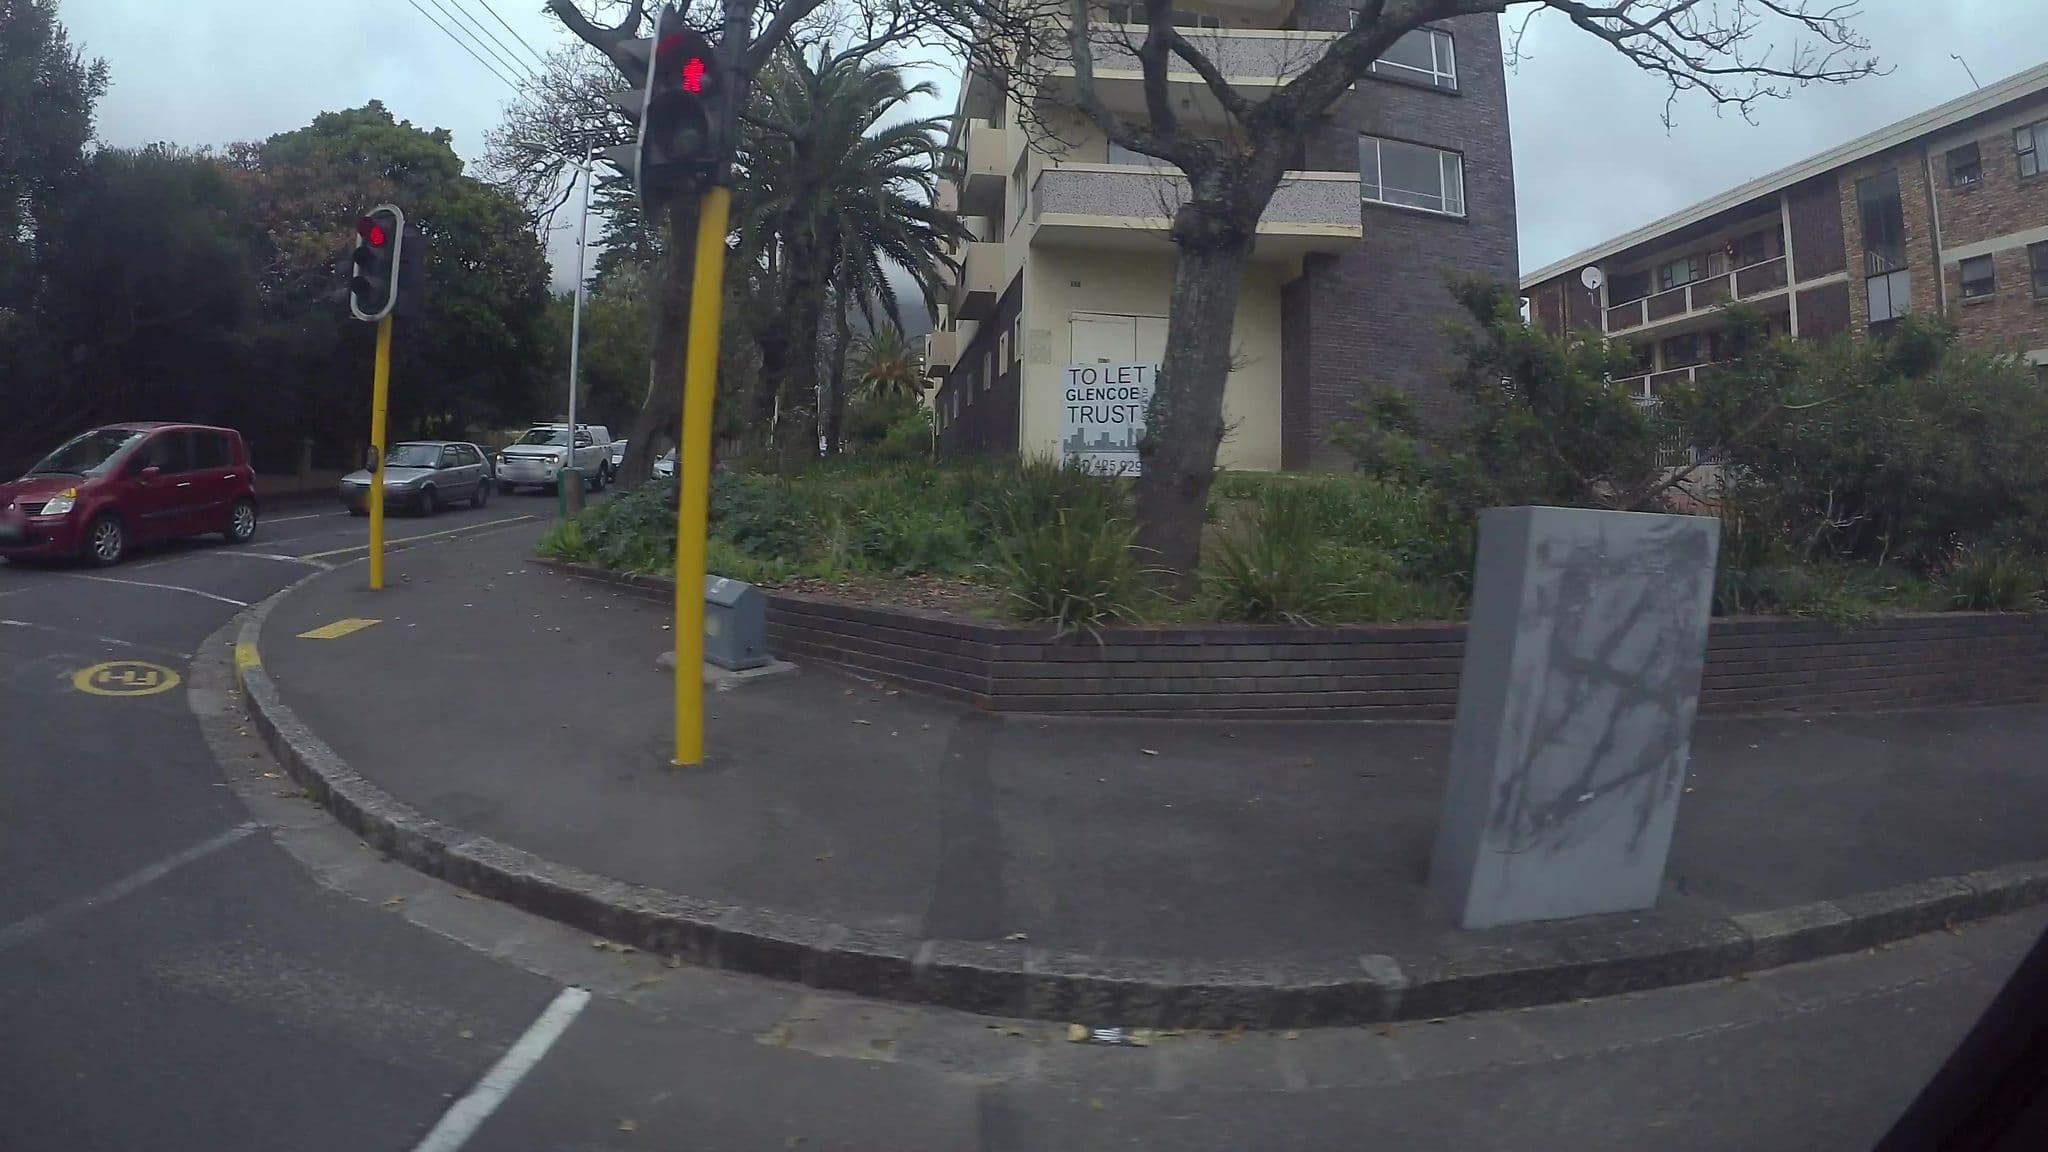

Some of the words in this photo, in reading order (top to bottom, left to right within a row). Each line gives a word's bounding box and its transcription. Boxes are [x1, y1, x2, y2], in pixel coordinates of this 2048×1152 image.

[1068, 368, 1097, 385] TO
[1105, 366, 1147, 384] LET
[1066, 387, 1140, 401] GLENCOE
[1067, 405, 1139, 423] TRUST
